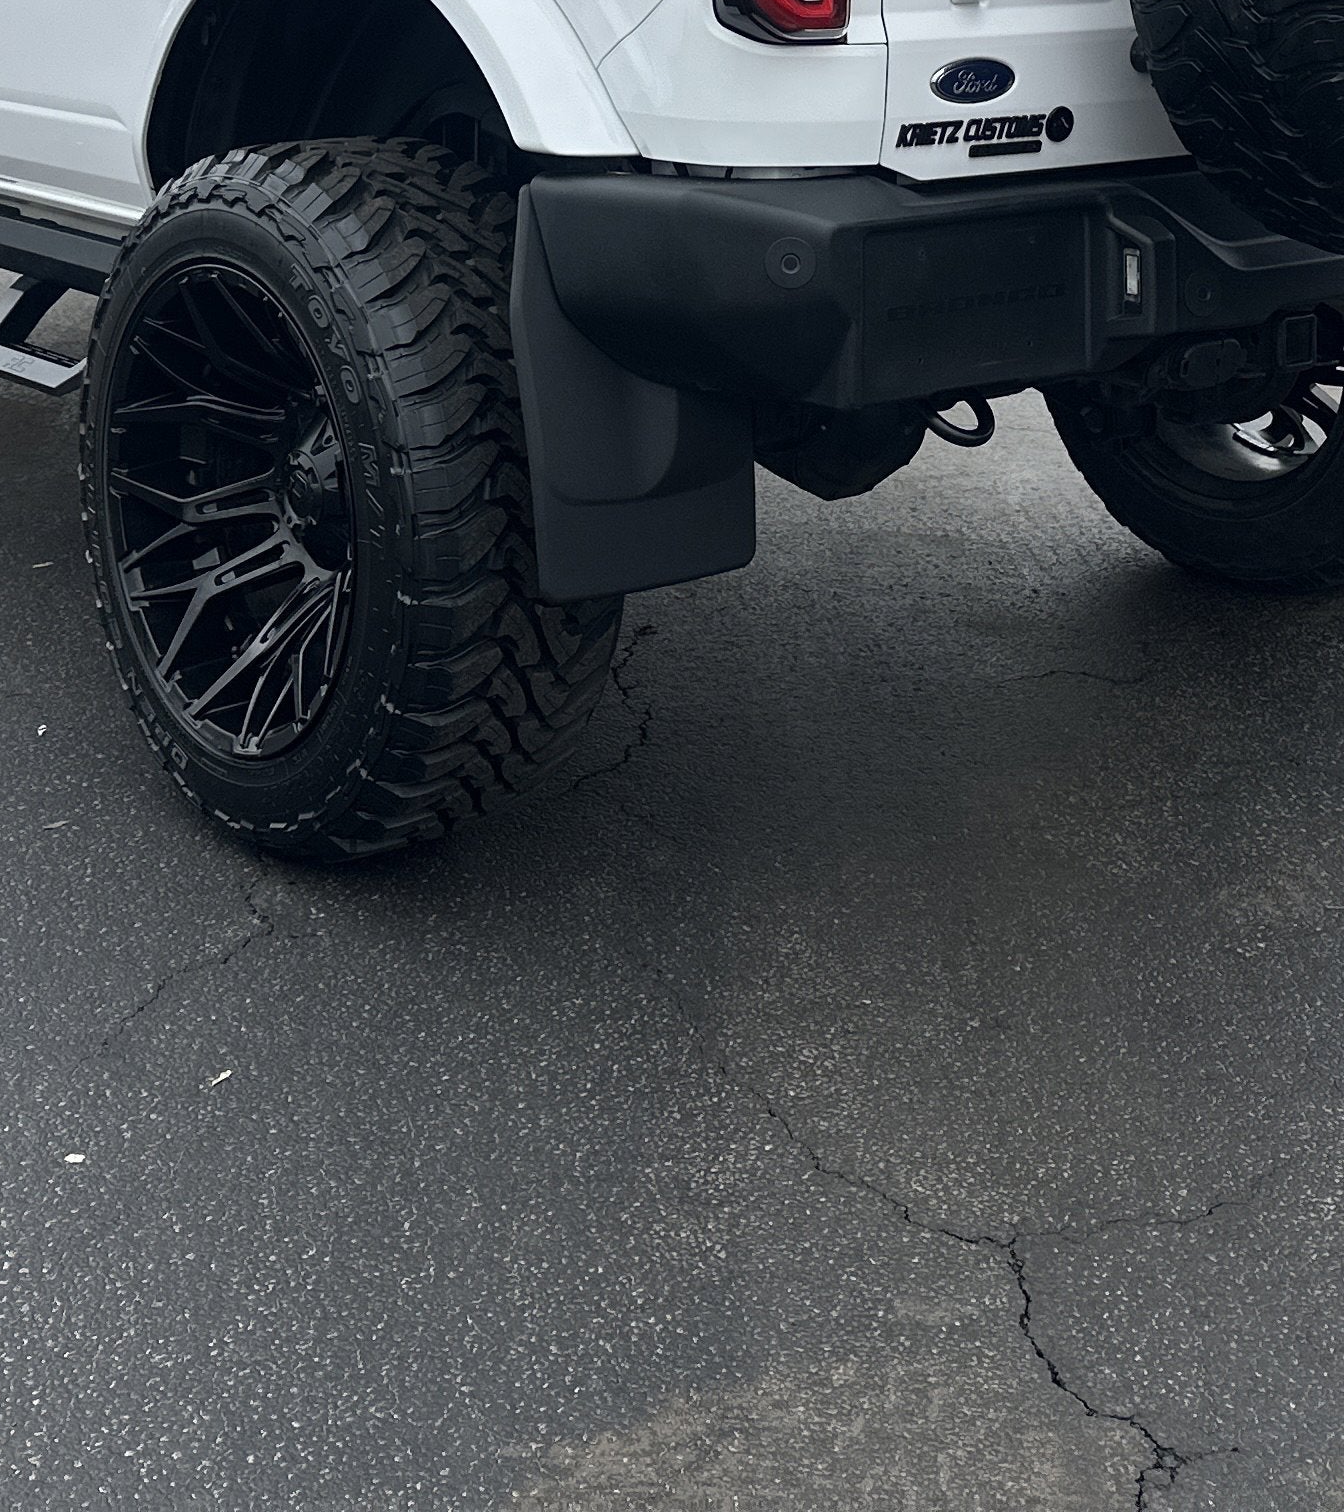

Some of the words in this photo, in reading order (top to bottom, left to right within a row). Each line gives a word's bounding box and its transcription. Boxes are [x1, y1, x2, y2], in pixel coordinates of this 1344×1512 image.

[953, 69, 999, 95] Ford
[963, 113, 1047, 142] CUSTOMS
[289, 263, 361, 405] TOYO
